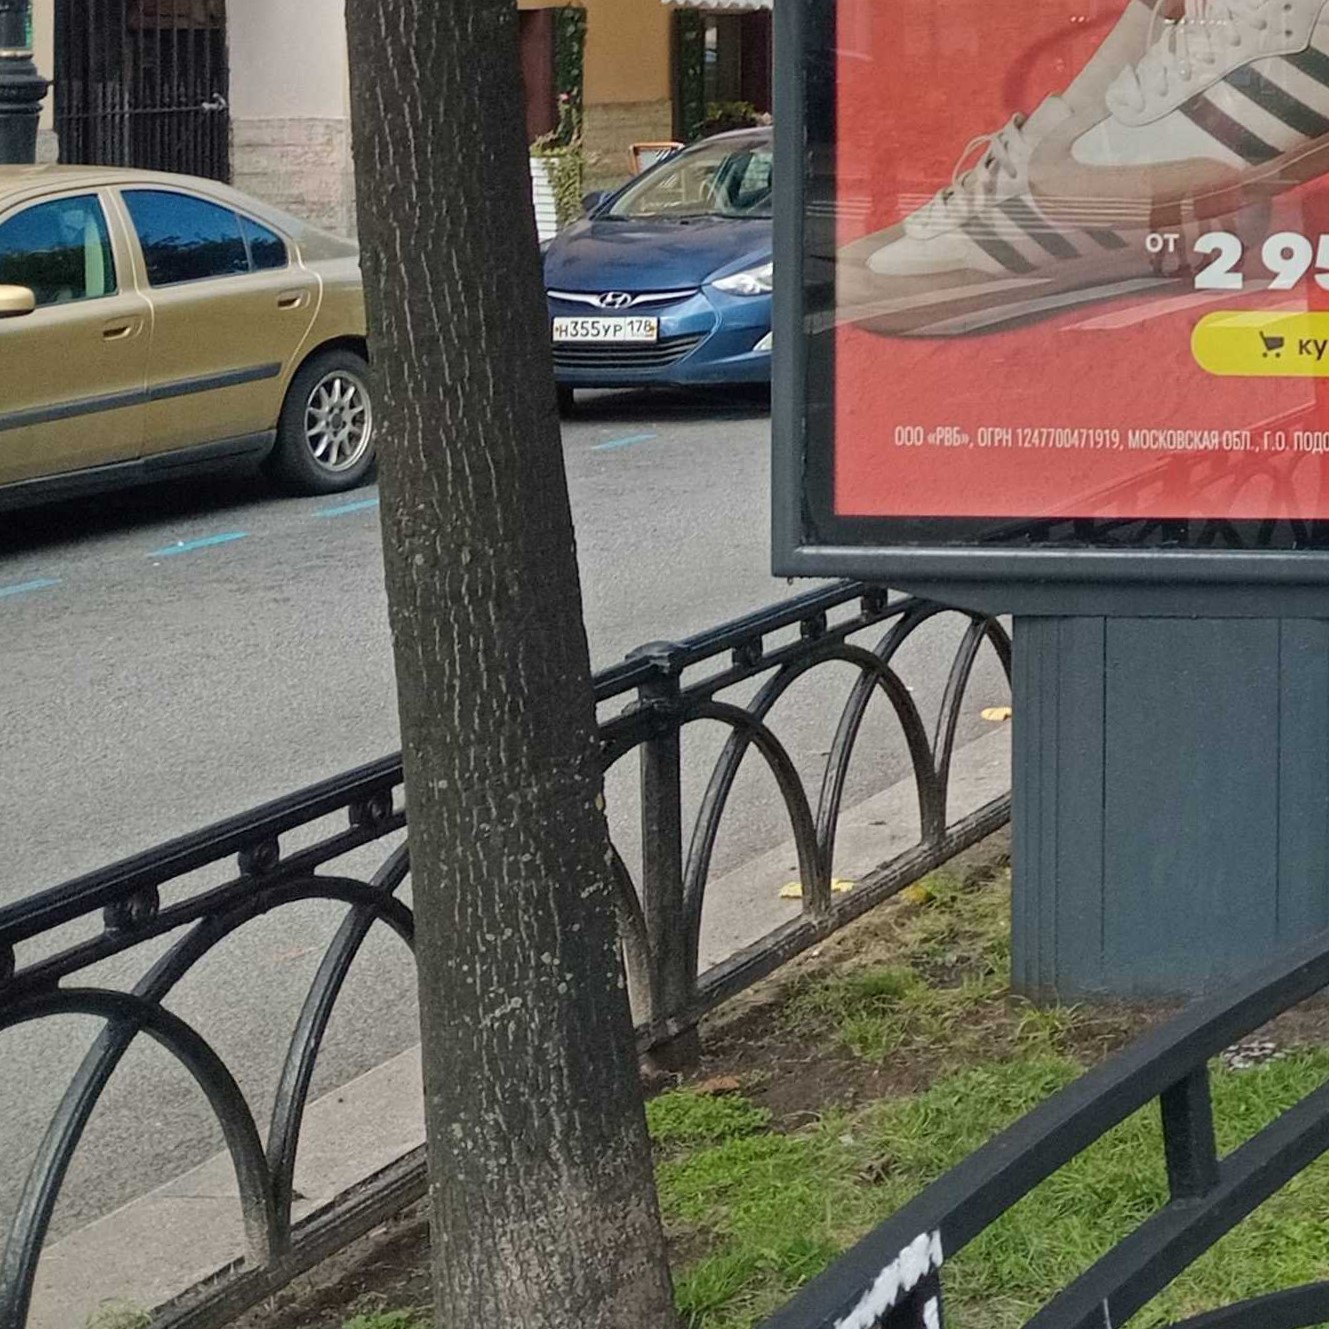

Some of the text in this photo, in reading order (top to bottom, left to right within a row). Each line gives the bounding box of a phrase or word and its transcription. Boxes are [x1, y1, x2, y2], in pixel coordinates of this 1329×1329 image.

[1193, 231, 1244, 289] 2
[895, 426, 924, 446] ООО
[977, 427, 1012, 447] ОГРН
[1128, 429, 1218, 450] МОСКОВСКАЯ
